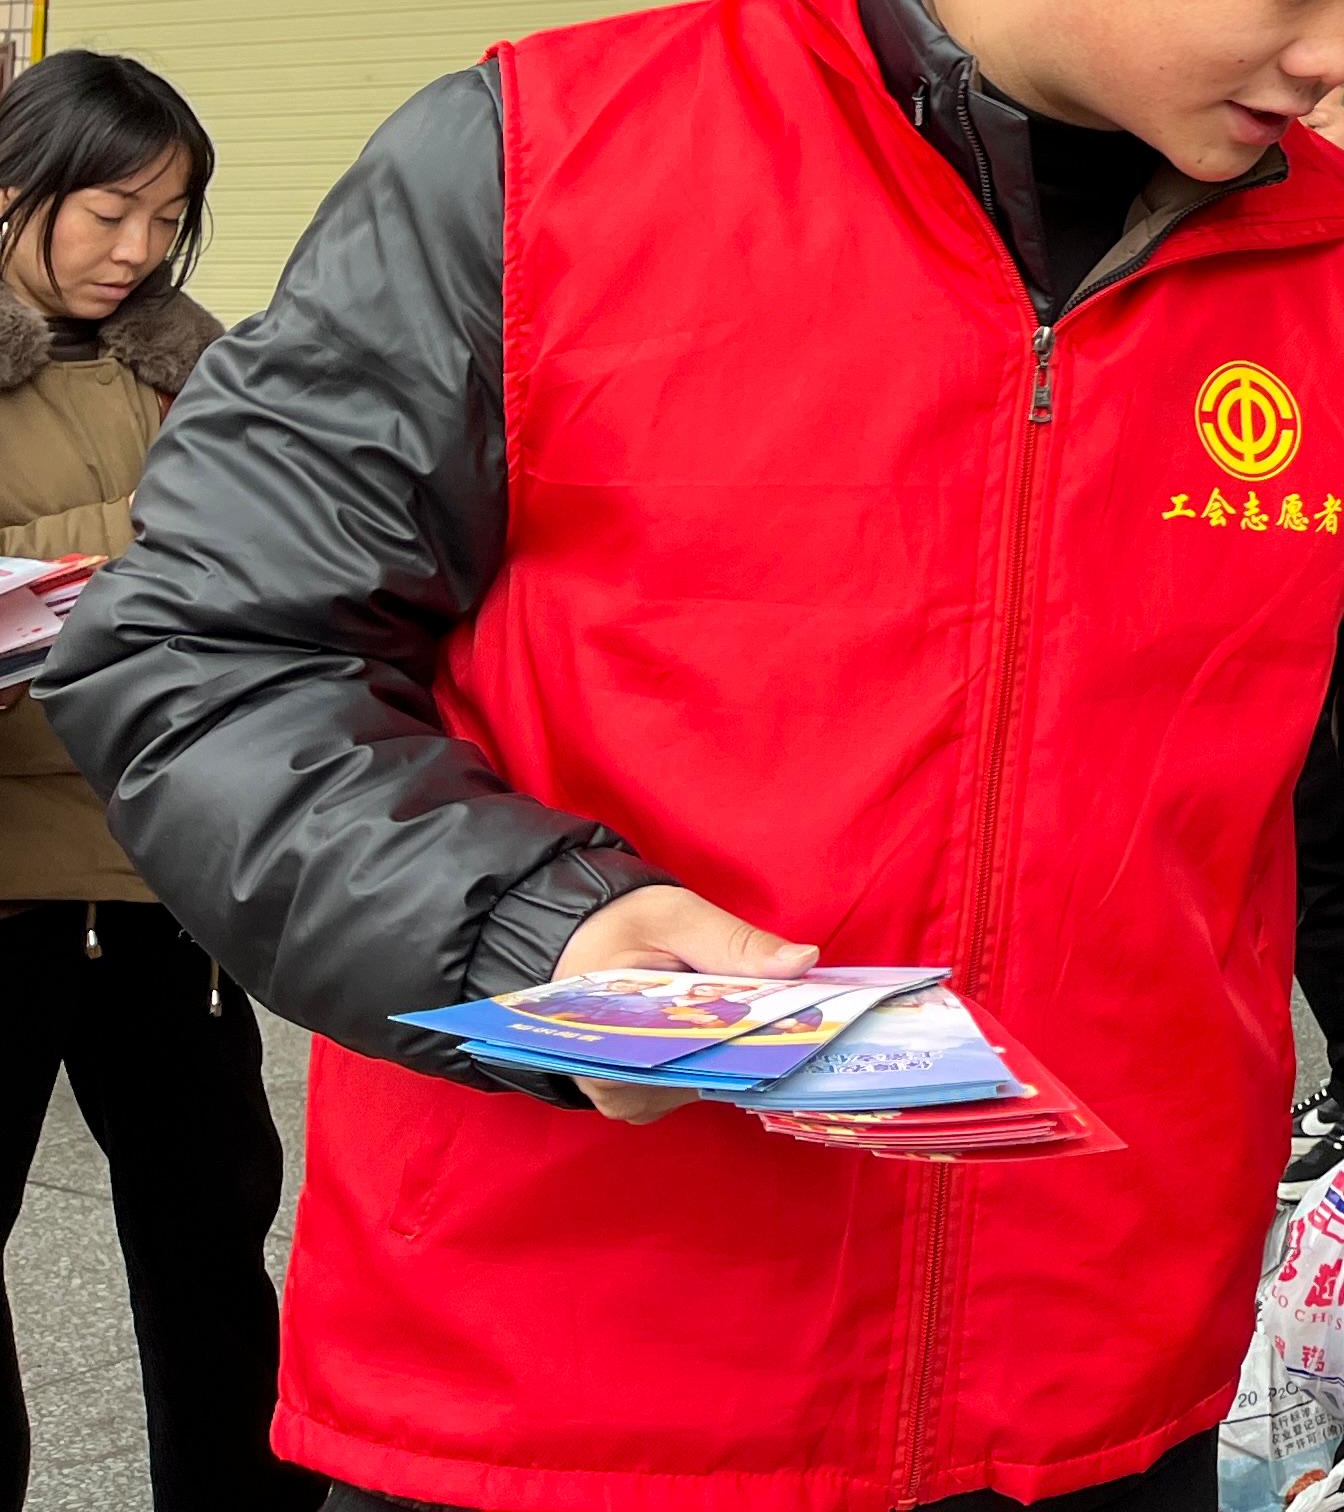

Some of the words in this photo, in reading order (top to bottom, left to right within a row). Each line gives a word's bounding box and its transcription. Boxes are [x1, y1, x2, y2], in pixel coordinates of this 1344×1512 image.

[1161, 486, 1343, 536] 工会志愿者
